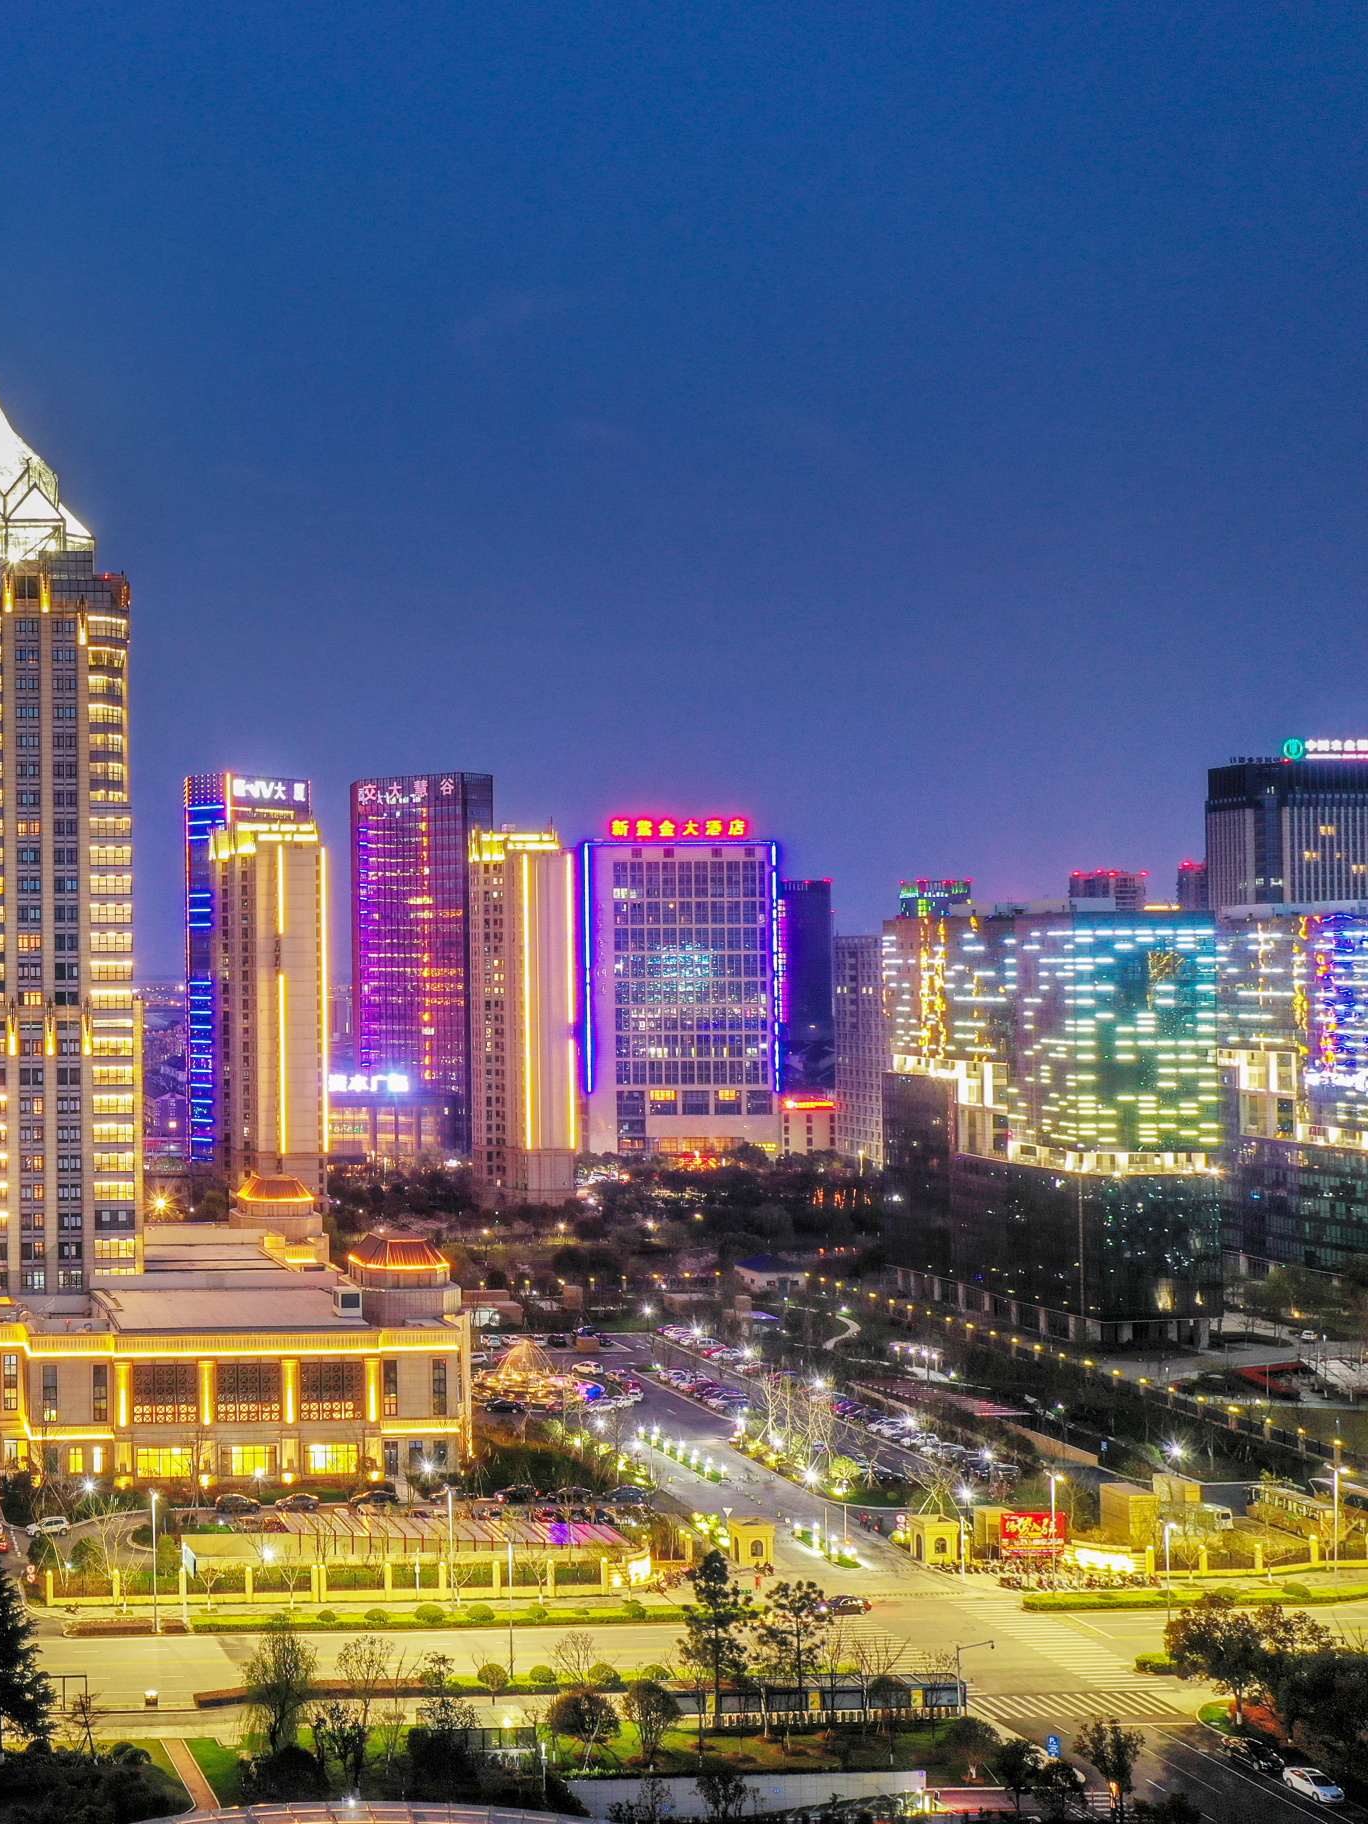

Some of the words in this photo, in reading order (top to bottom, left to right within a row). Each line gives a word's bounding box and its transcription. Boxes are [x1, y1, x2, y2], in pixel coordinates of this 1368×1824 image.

[363, 778, 455, 801] 交大慧谷
[611, 819, 746, 836] 新紫金大酒店
